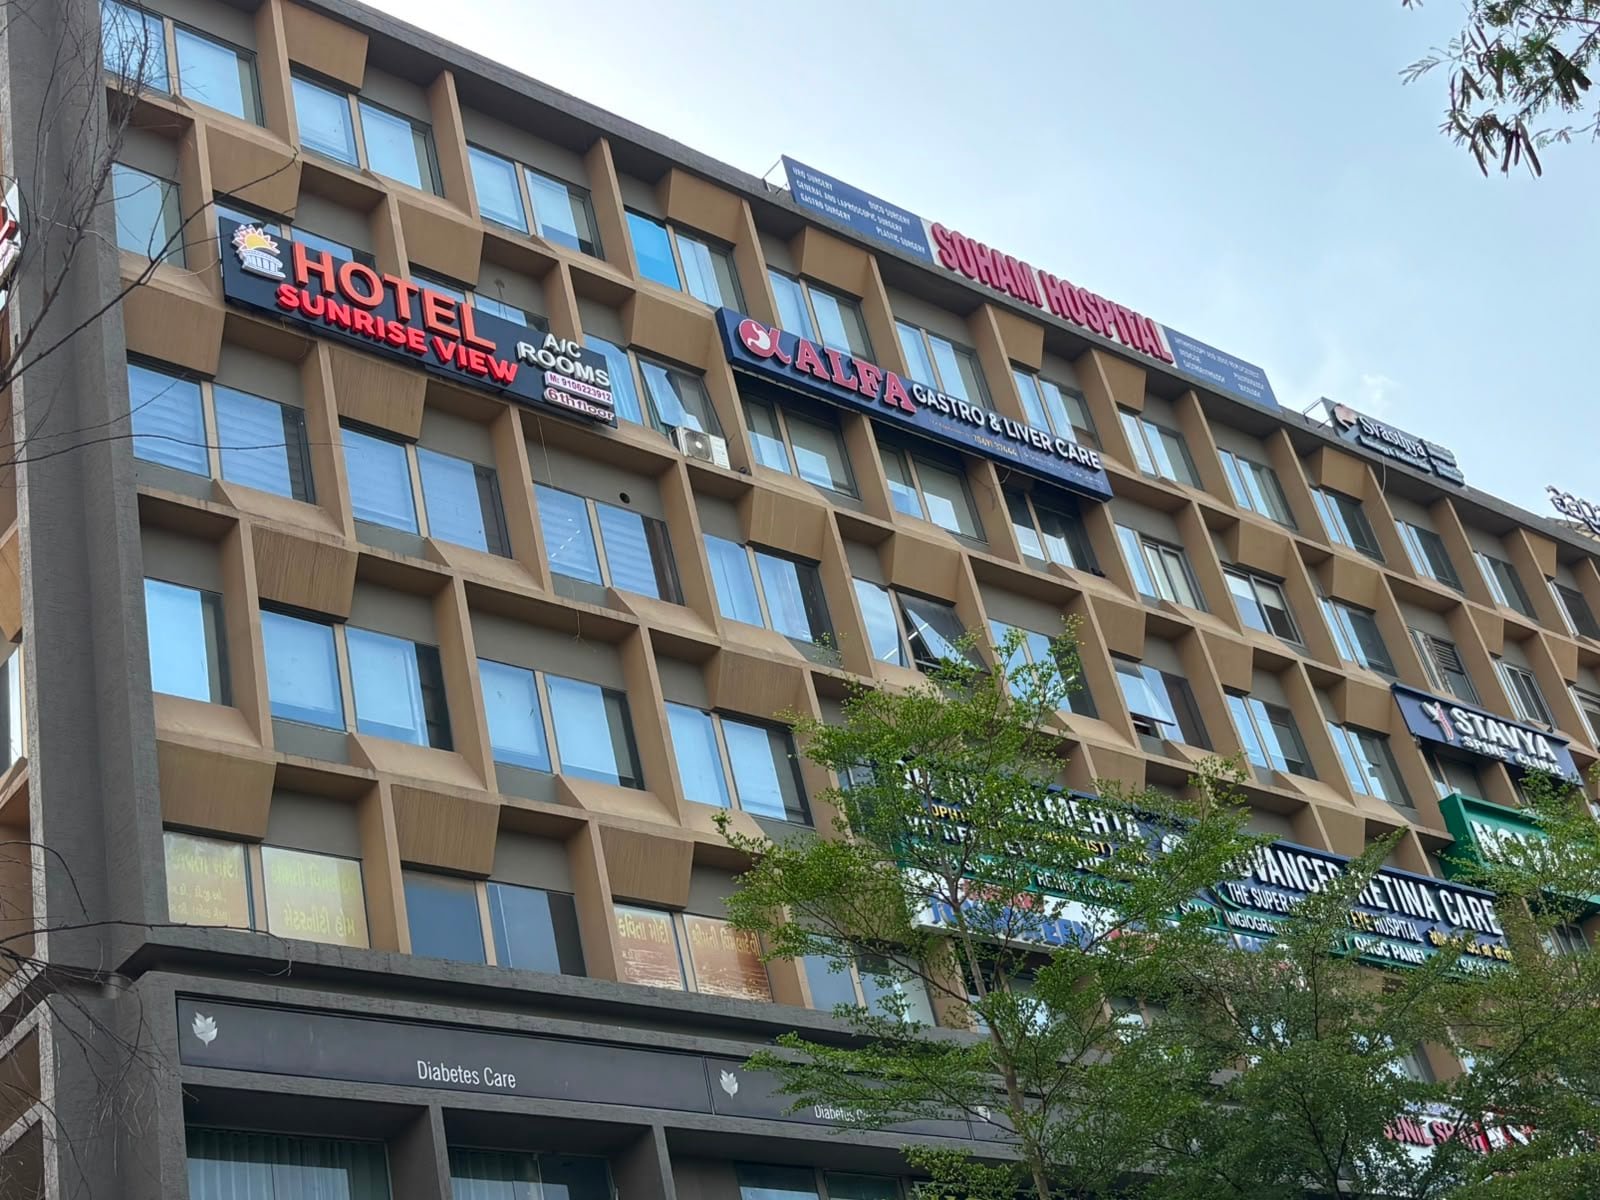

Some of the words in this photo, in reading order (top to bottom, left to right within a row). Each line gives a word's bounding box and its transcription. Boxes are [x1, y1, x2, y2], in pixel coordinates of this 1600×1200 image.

[796, 179, 823, 199] GENERAL
[824, 203, 851, 221] SURGERY
[292, 240, 497, 352] HOTEL
[930, 222, 1044, 308] SOHAM
[1038, 269, 1174, 364] HOSPITAL
[276, 283, 428, 355] SUNRISE
[431, 334, 519, 385] VIEW
[516, 341, 611, 387] ROOMS
[795, 337, 917, 415] ALFA
[911, 383, 986, 428] GASTRO
[988, 412, 1003, 433] &
[1004, 420, 1054, 453] LIVER
[1055, 438, 1102, 470] CARE
[1450, 706, 1559, 763] STAVYA
[1461, 735, 1509, 760] SPINE
[1514, 752, 1565, 776] CLINIC
[1226, 881, 1251, 905] THE
[1250, 886, 1289, 913] SUPER
[1439, 888, 1505, 936] CARE
[1350, 909, 1374, 932] EYE
[1372, 914, 1424, 943] HOSPITAL
[416, 1059, 480, 1085] Diabetes
[483, 1066, 517, 1089] Care
